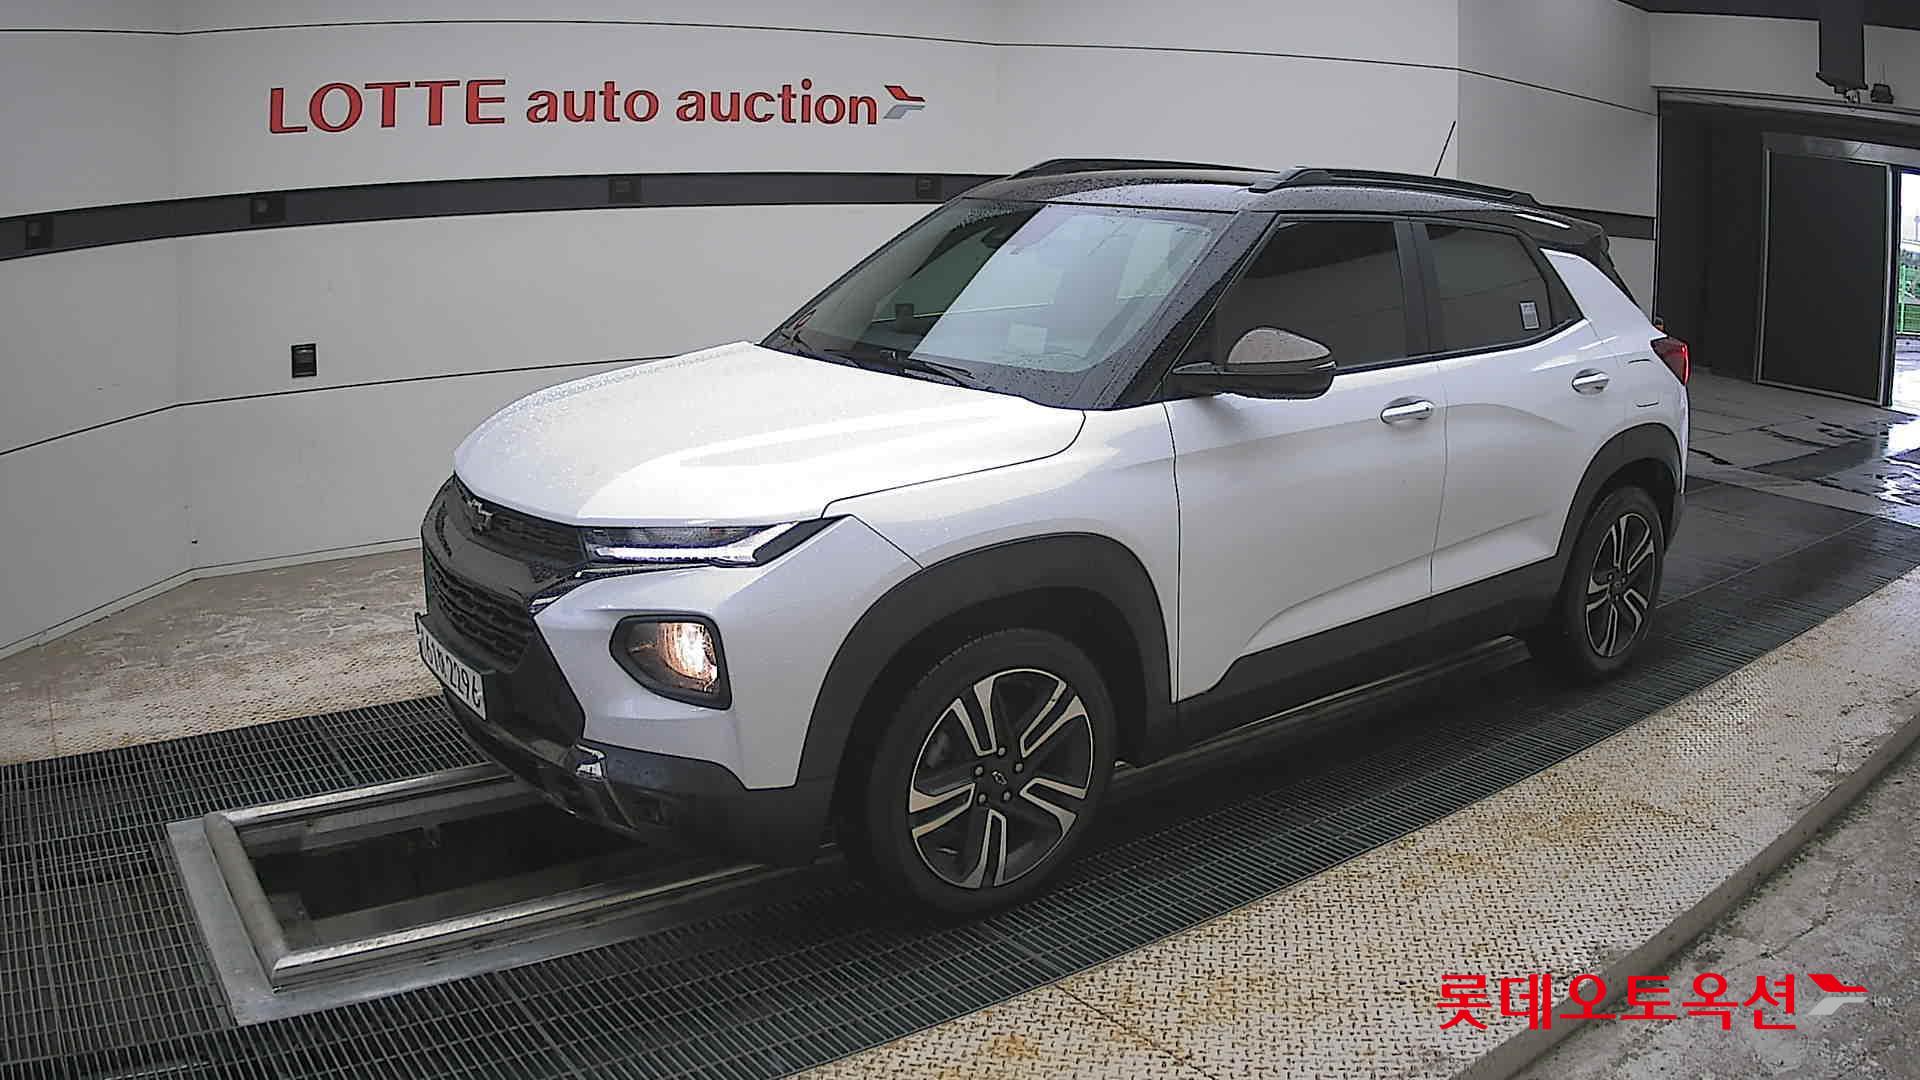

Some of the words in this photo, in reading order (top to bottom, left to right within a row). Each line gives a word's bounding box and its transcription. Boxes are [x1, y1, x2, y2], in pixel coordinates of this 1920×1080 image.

[269, 79, 506, 134] LOTTE
[526, 80, 659, 124] auto
[675, 78, 878, 125] auction
